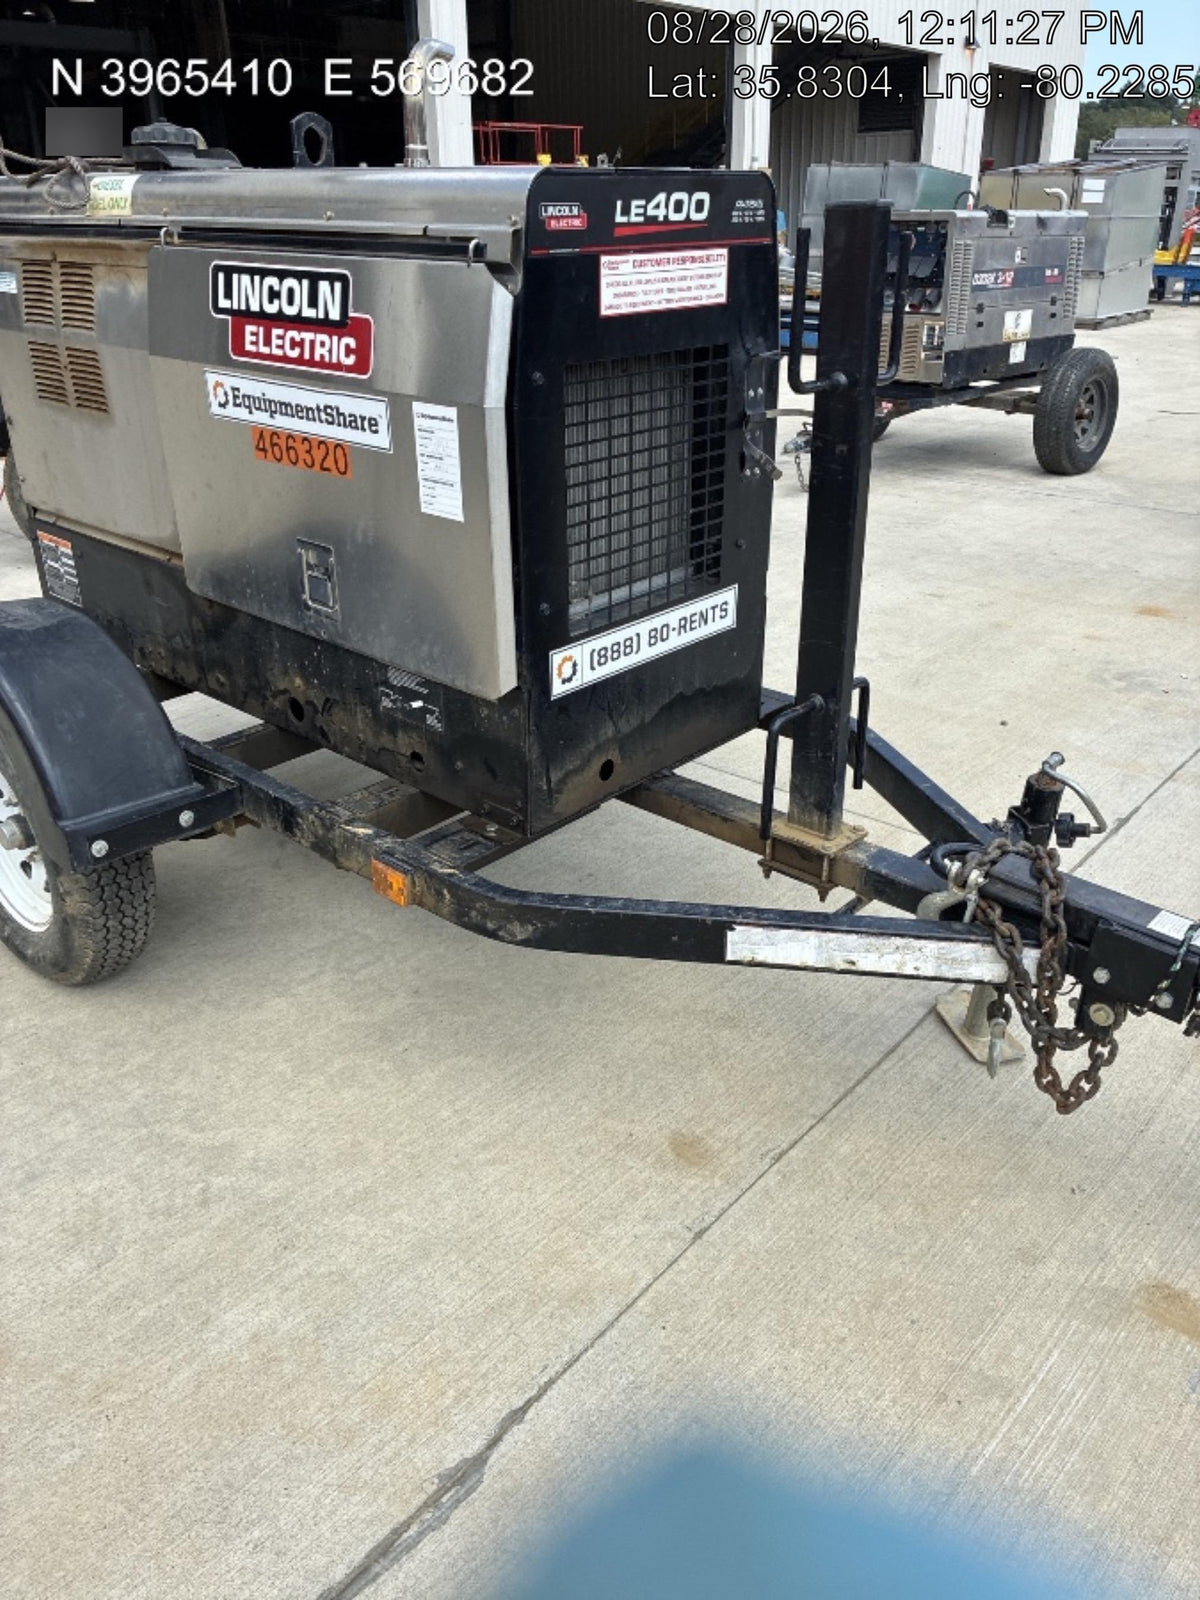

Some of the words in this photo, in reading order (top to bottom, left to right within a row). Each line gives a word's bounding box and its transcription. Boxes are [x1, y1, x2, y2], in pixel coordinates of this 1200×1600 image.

[614, 191, 711, 223] LE400
[217, 271, 342, 321] LINCOLN
[244, 324, 357, 366] ELECTRIC
[230, 385, 380, 435] EquipmentShare
[255, 429, 349, 476] 466320
[589, 632, 641, 672] (888)
